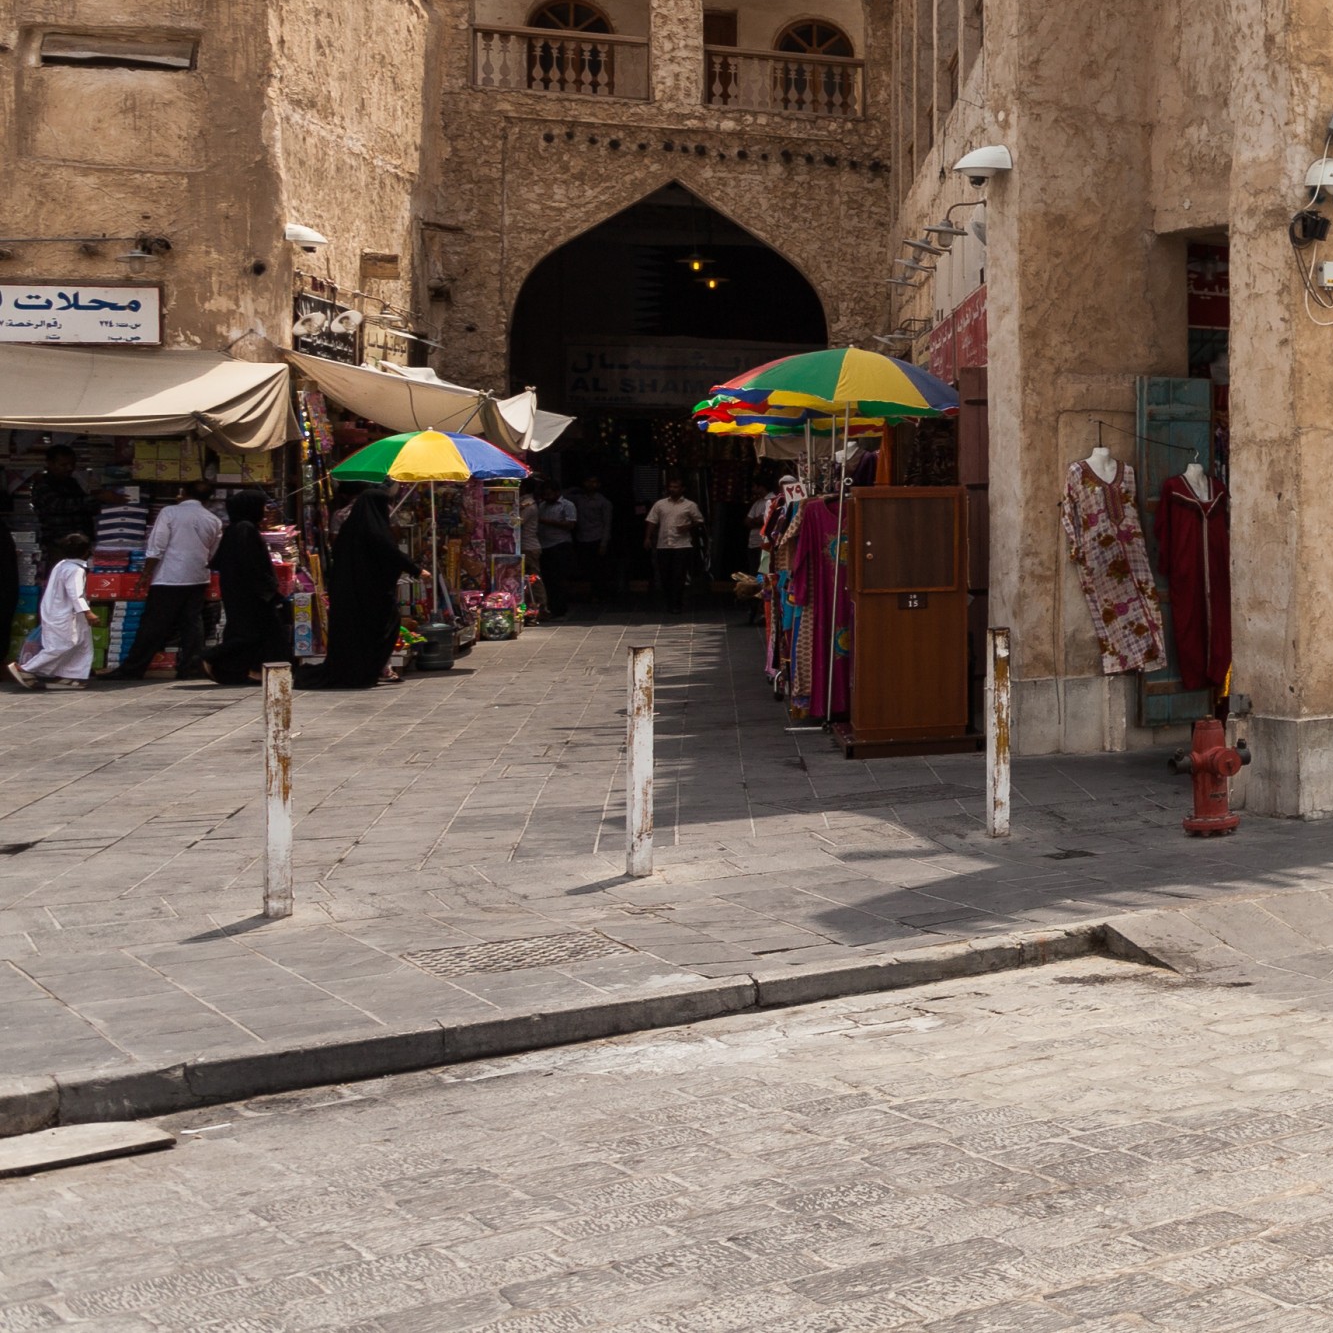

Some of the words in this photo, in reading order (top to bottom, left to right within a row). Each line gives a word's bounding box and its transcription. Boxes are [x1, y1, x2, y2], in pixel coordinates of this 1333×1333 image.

[13, 290, 142, 313] محلات
[570, 377, 608, 392] AL
[908, 599, 919, 608] 15
